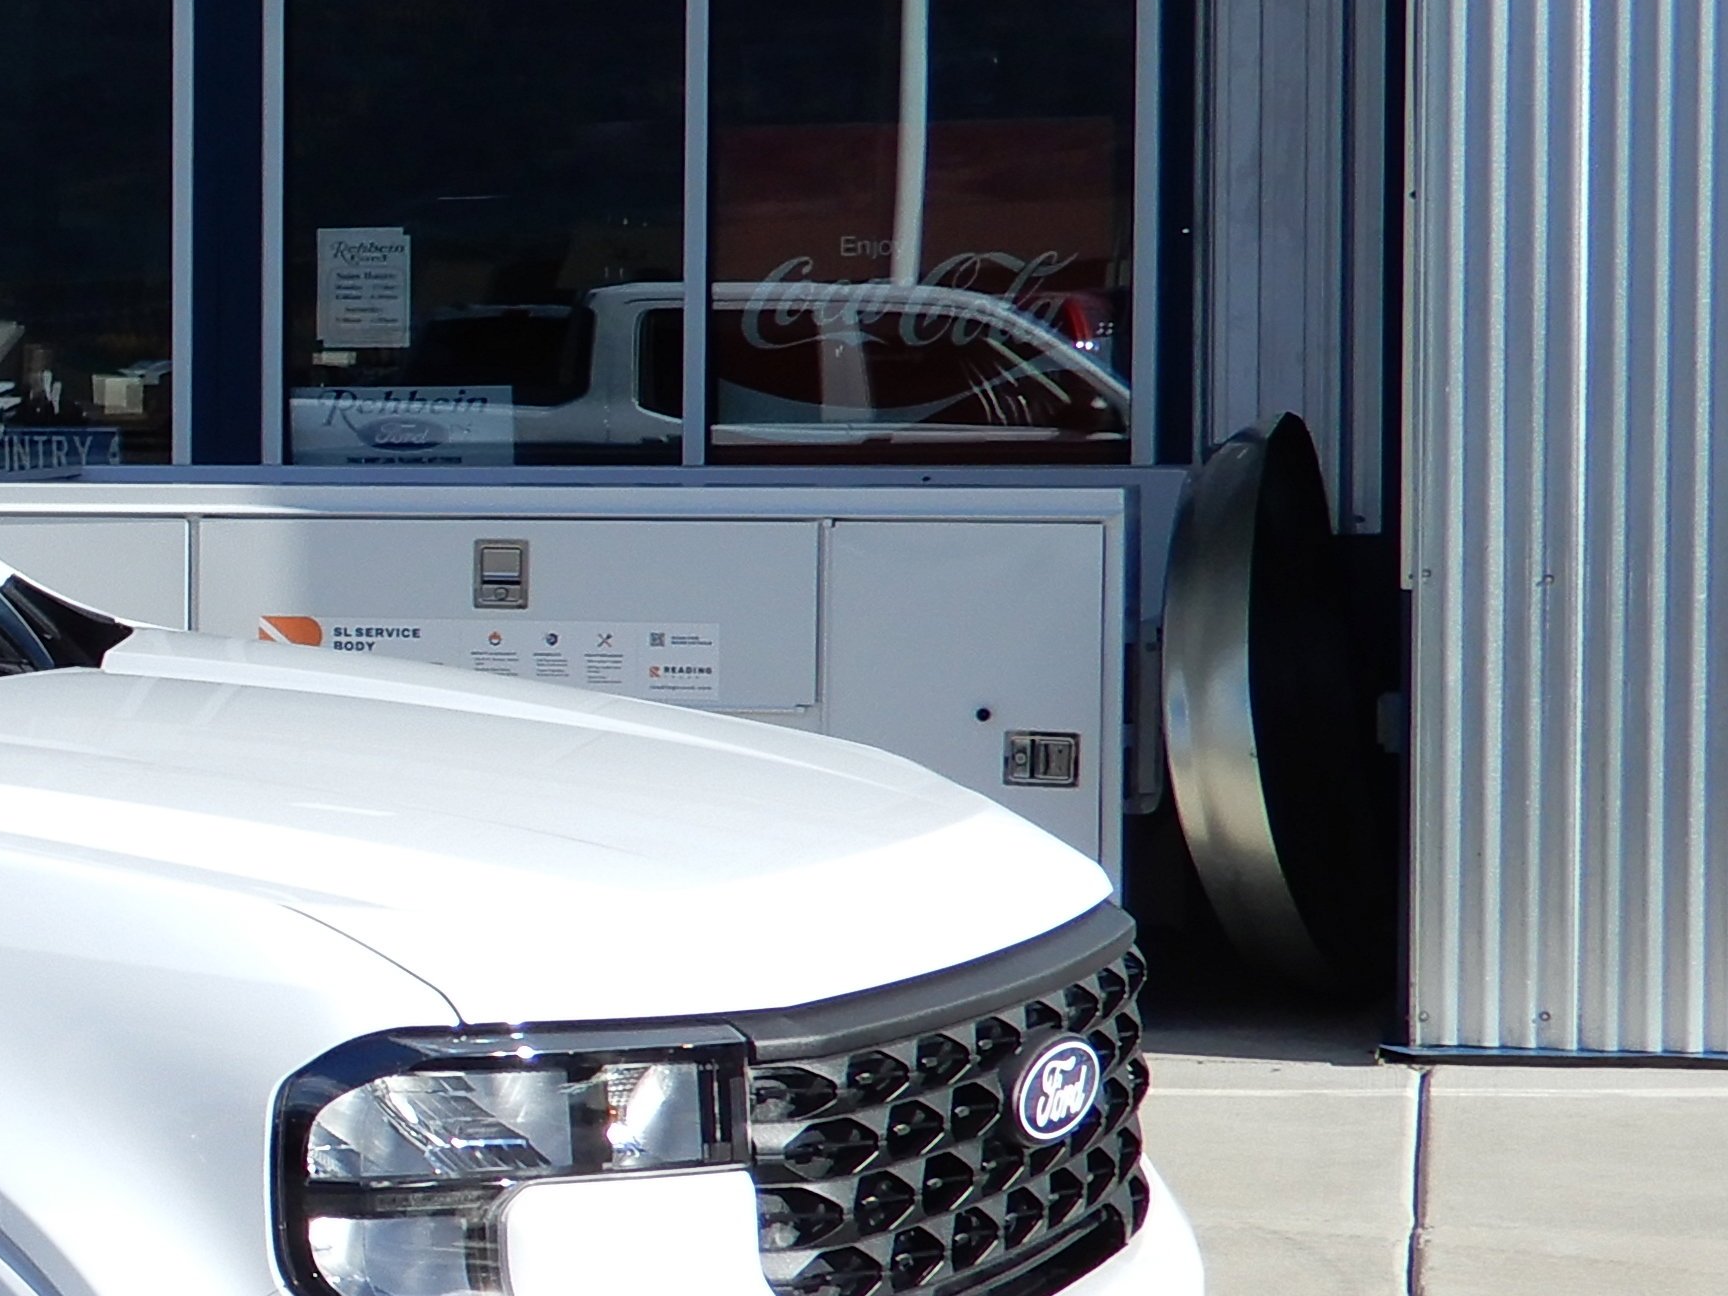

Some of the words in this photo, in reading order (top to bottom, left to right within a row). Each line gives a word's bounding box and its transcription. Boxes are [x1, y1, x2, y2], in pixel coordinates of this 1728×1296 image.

[330, 241, 405, 264] Rehbein
[319, 389, 488, 427] Rehbein
[374, 422, 429, 445] Ford
[333, 627, 351, 638] SL
[355, 627, 421, 639] SERVICE
[333, 641, 376, 651] BODY
[663, 666, 713, 675] READING
[1036, 1055, 1087, 1128] Ford
